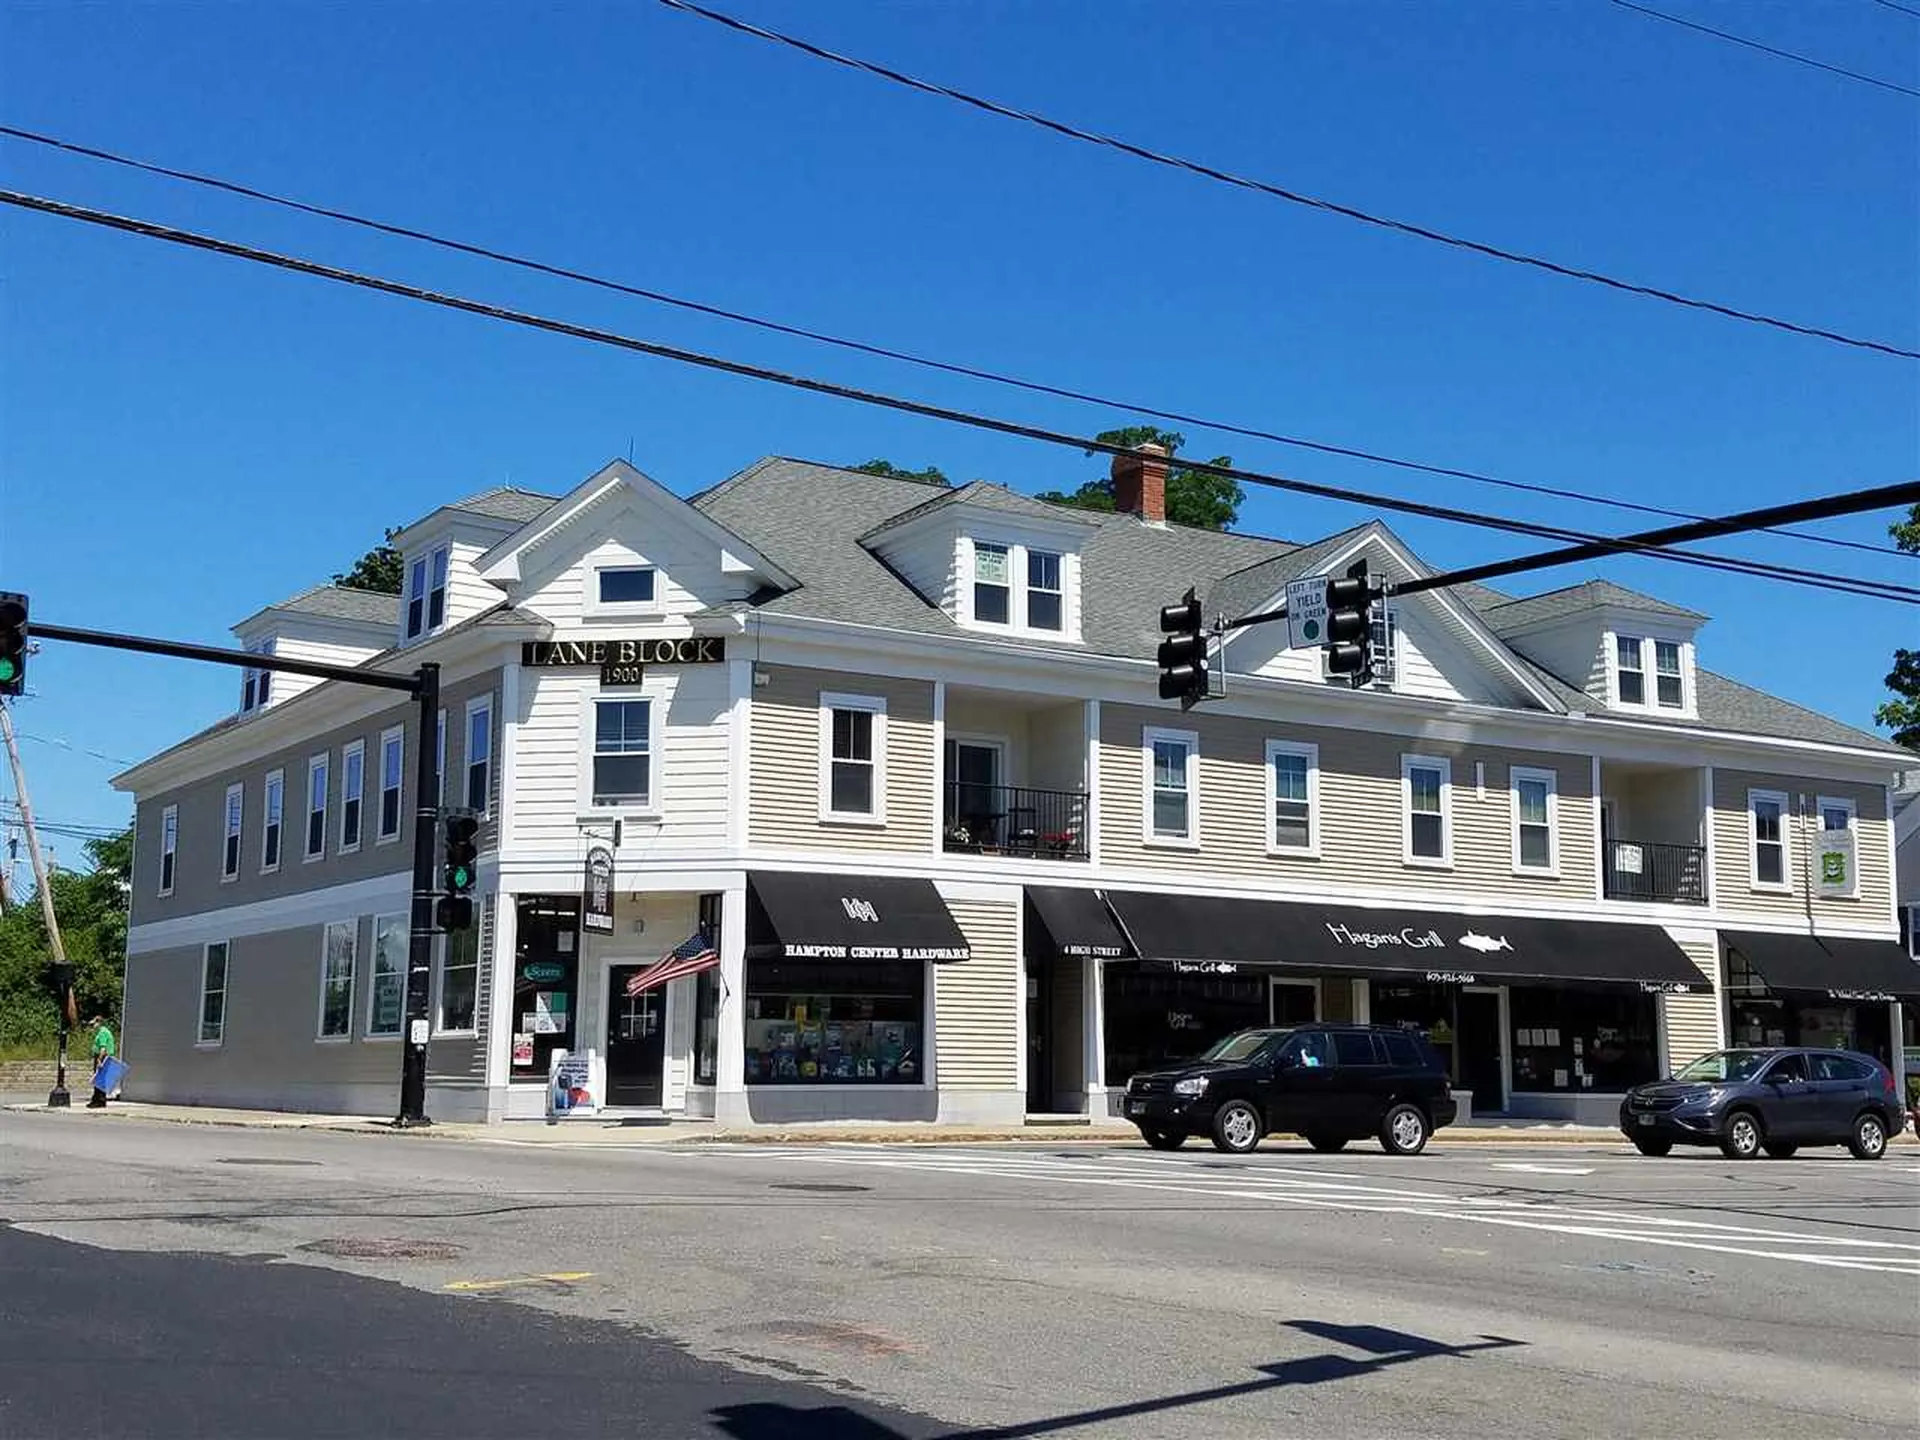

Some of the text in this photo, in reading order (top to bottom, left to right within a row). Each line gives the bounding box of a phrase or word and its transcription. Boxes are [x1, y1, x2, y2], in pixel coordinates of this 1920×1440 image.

[1296, 592, 1322, 608] YIELD
[531, 639, 716, 665] LANE BLOCK
[604, 667, 640, 684] 1900
[1325, 923, 1446, 949] Hagan's Grill
[785, 944, 970, 960] HAMPTON CENTER HARDWARE
[1092, 946, 1122, 956] STREET
